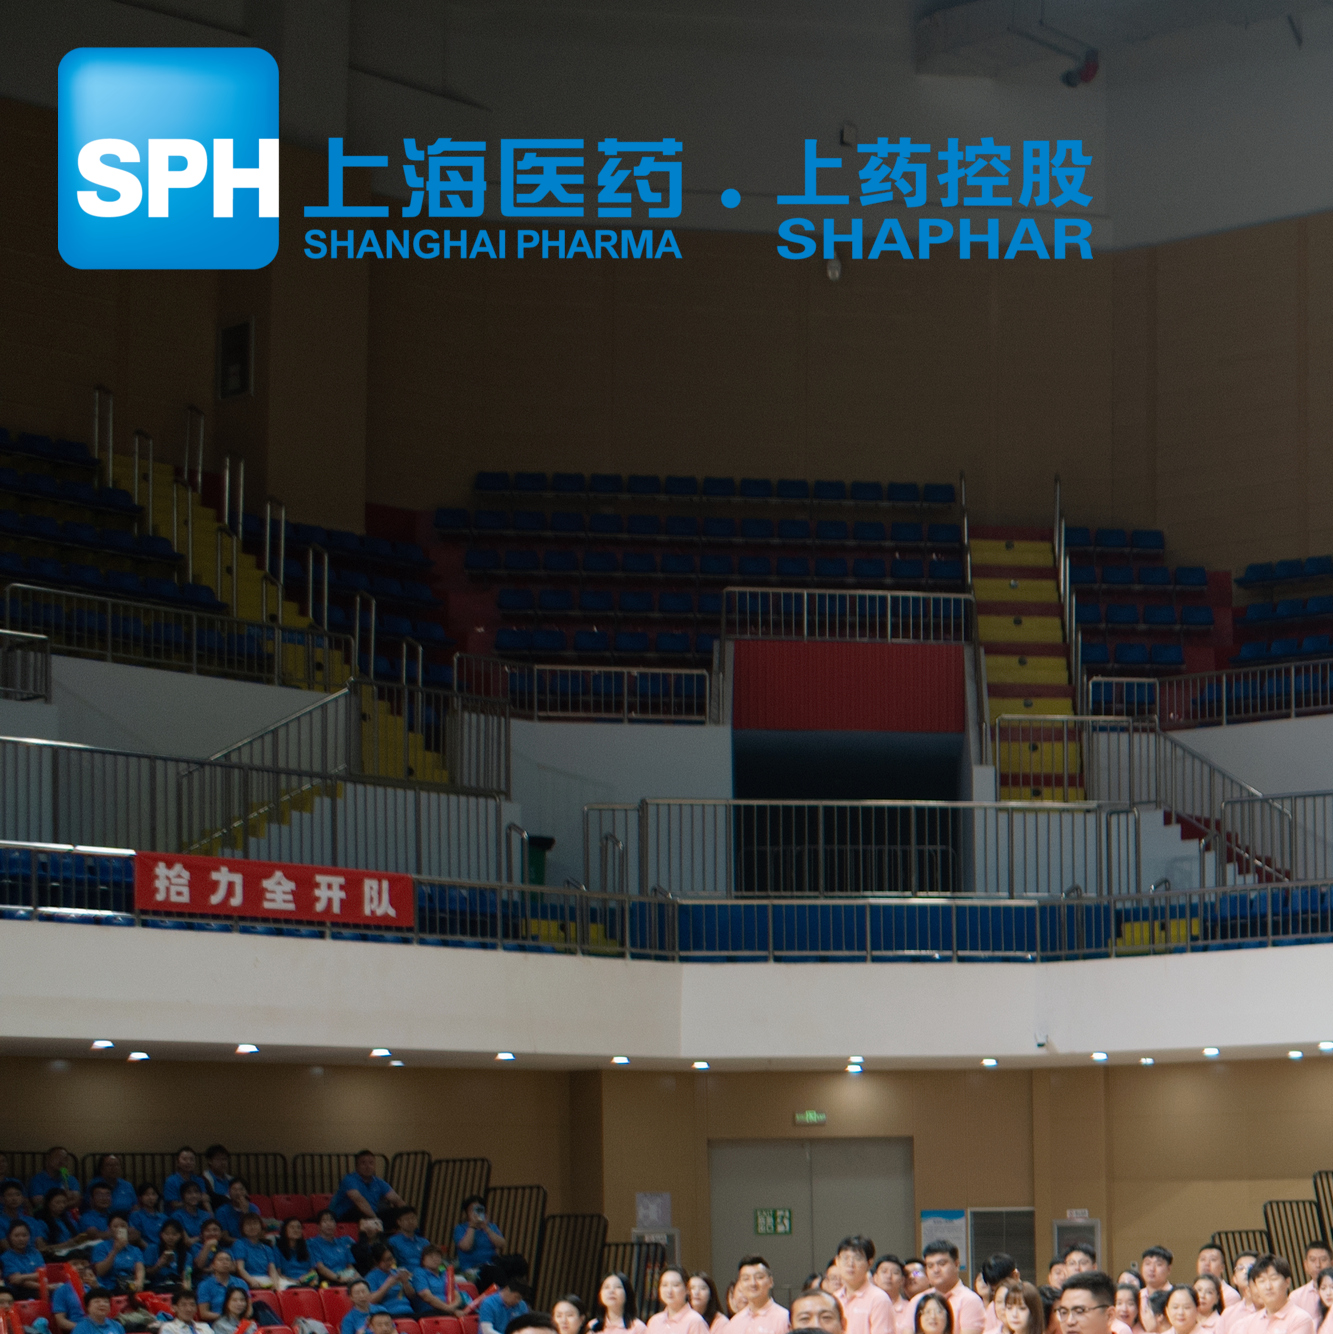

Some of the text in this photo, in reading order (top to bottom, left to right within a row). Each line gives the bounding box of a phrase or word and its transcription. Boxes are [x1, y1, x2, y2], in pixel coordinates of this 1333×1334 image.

[154, 861, 396, 918] 拾力全开队
